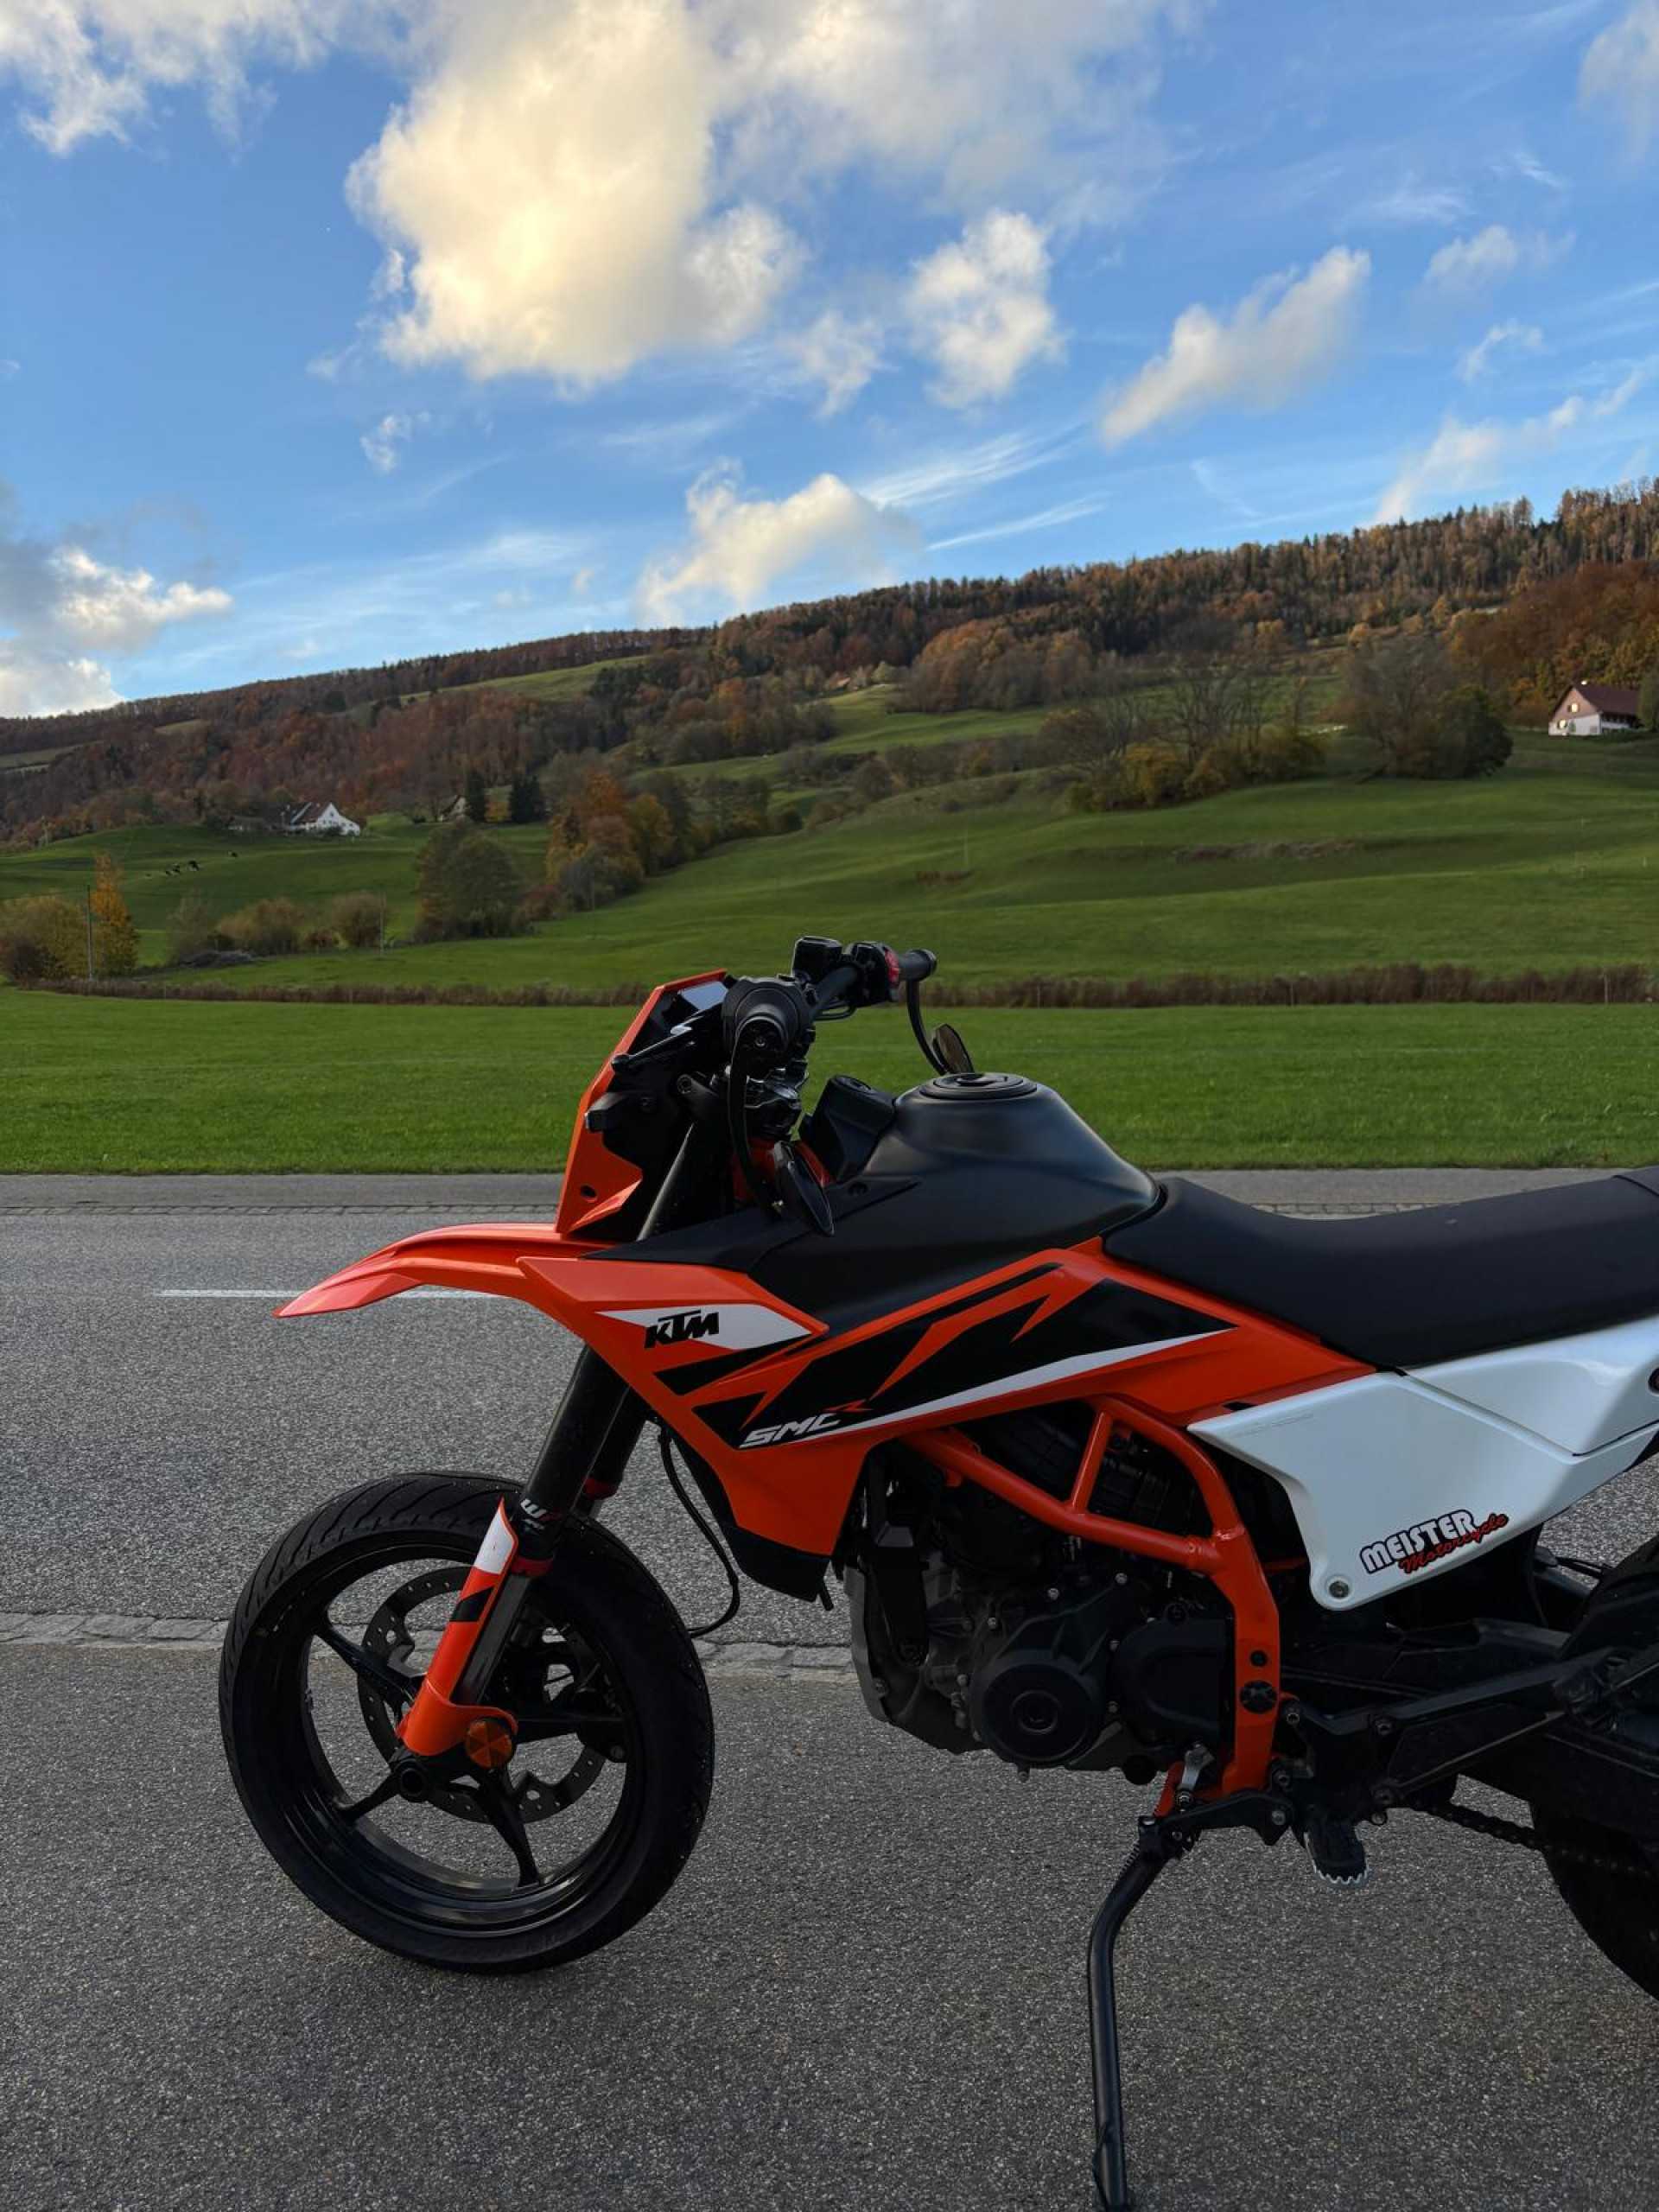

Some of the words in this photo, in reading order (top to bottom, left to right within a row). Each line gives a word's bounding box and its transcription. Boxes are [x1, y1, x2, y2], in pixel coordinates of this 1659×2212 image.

[645, 1309, 720, 1349] KTM
[739, 1413, 841, 1449] SMC
[1359, 1509, 1478, 1574] MEISTER
[1398, 1512, 1510, 1574] Motorcycle
